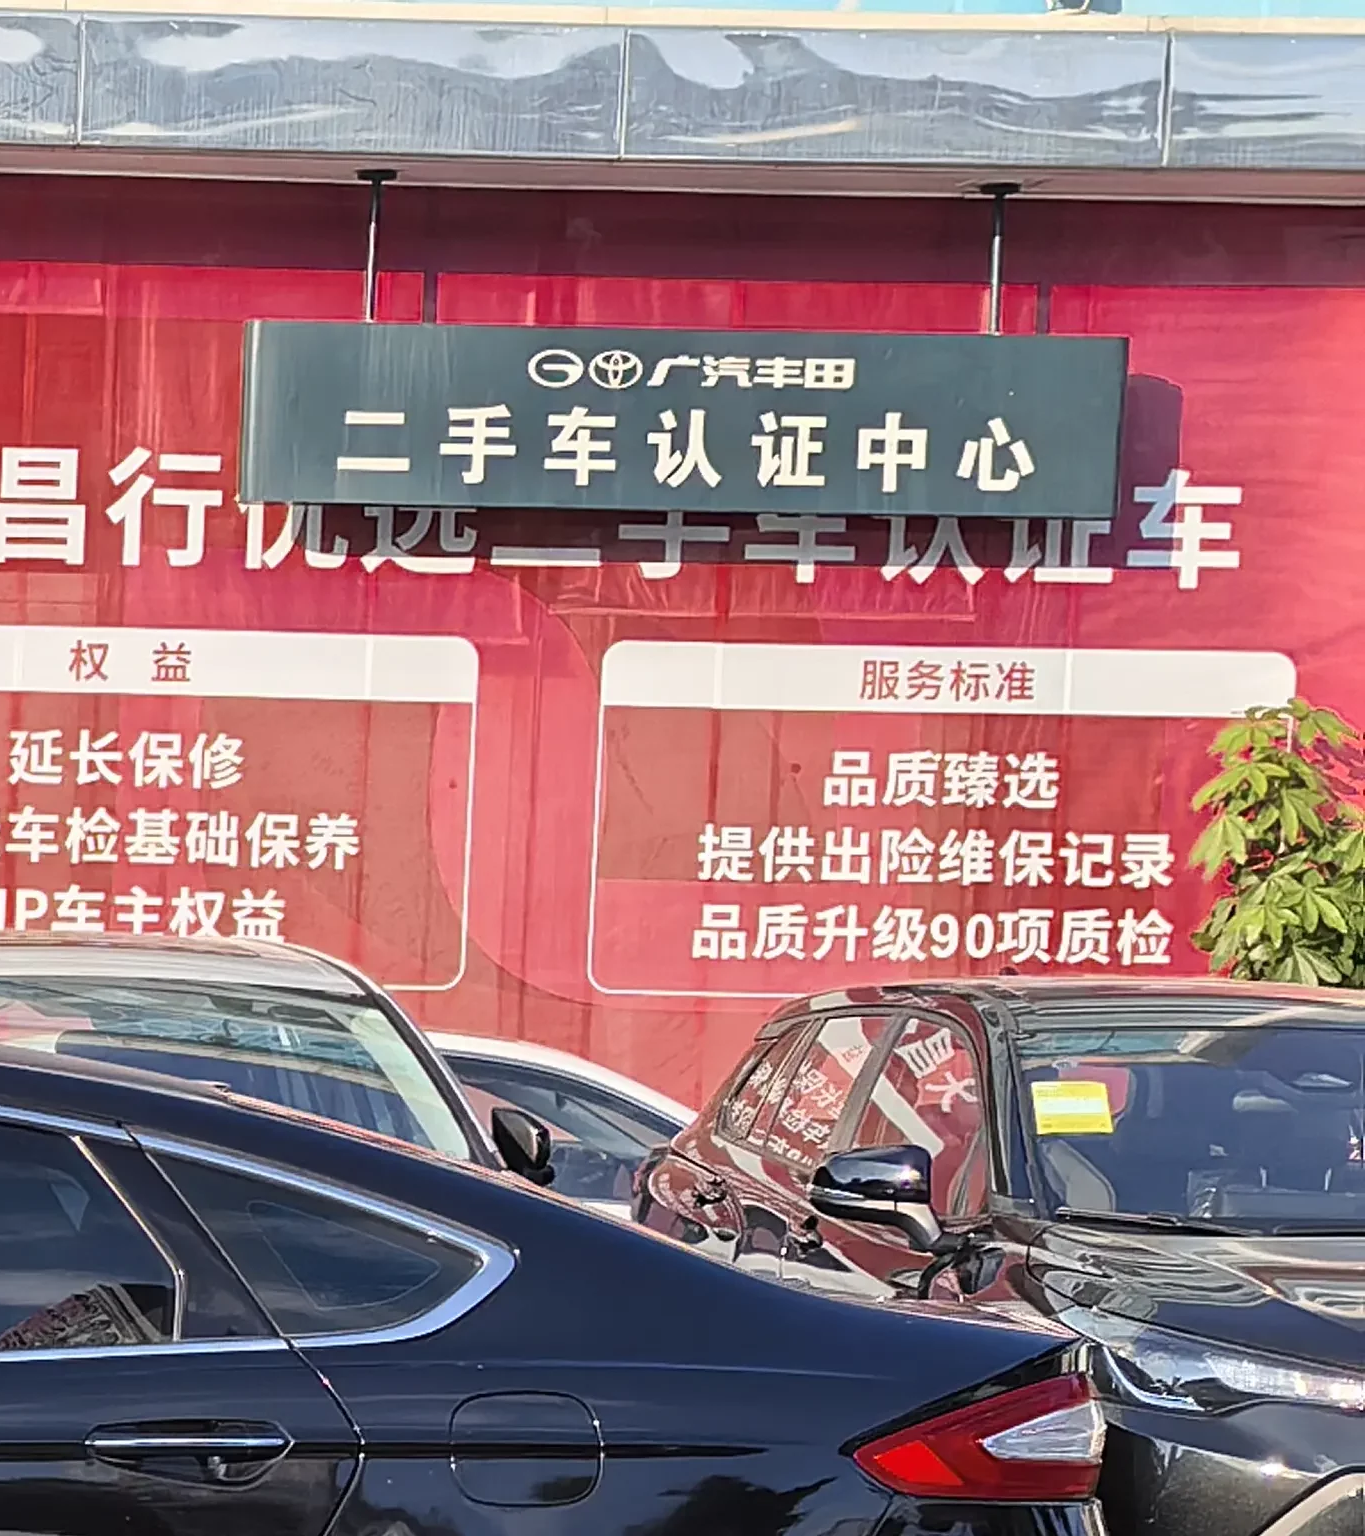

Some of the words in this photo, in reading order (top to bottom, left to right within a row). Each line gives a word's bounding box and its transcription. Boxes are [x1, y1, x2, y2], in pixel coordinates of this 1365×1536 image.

[646, 354, 856, 390] 广汽丰田
[335, 404, 1036, 496] 二手车认证中心
[68, 640, 193, 683] 权益
[859, 660, 1037, 702] 服务标准
[7, 729, 246, 791] 延长保修
[823, 749, 1061, 810] 品质臻选
[697, 823, 1175, 890] 提供出险维保记录
[691, 904, 1173, 967] 品质升级90项质检
